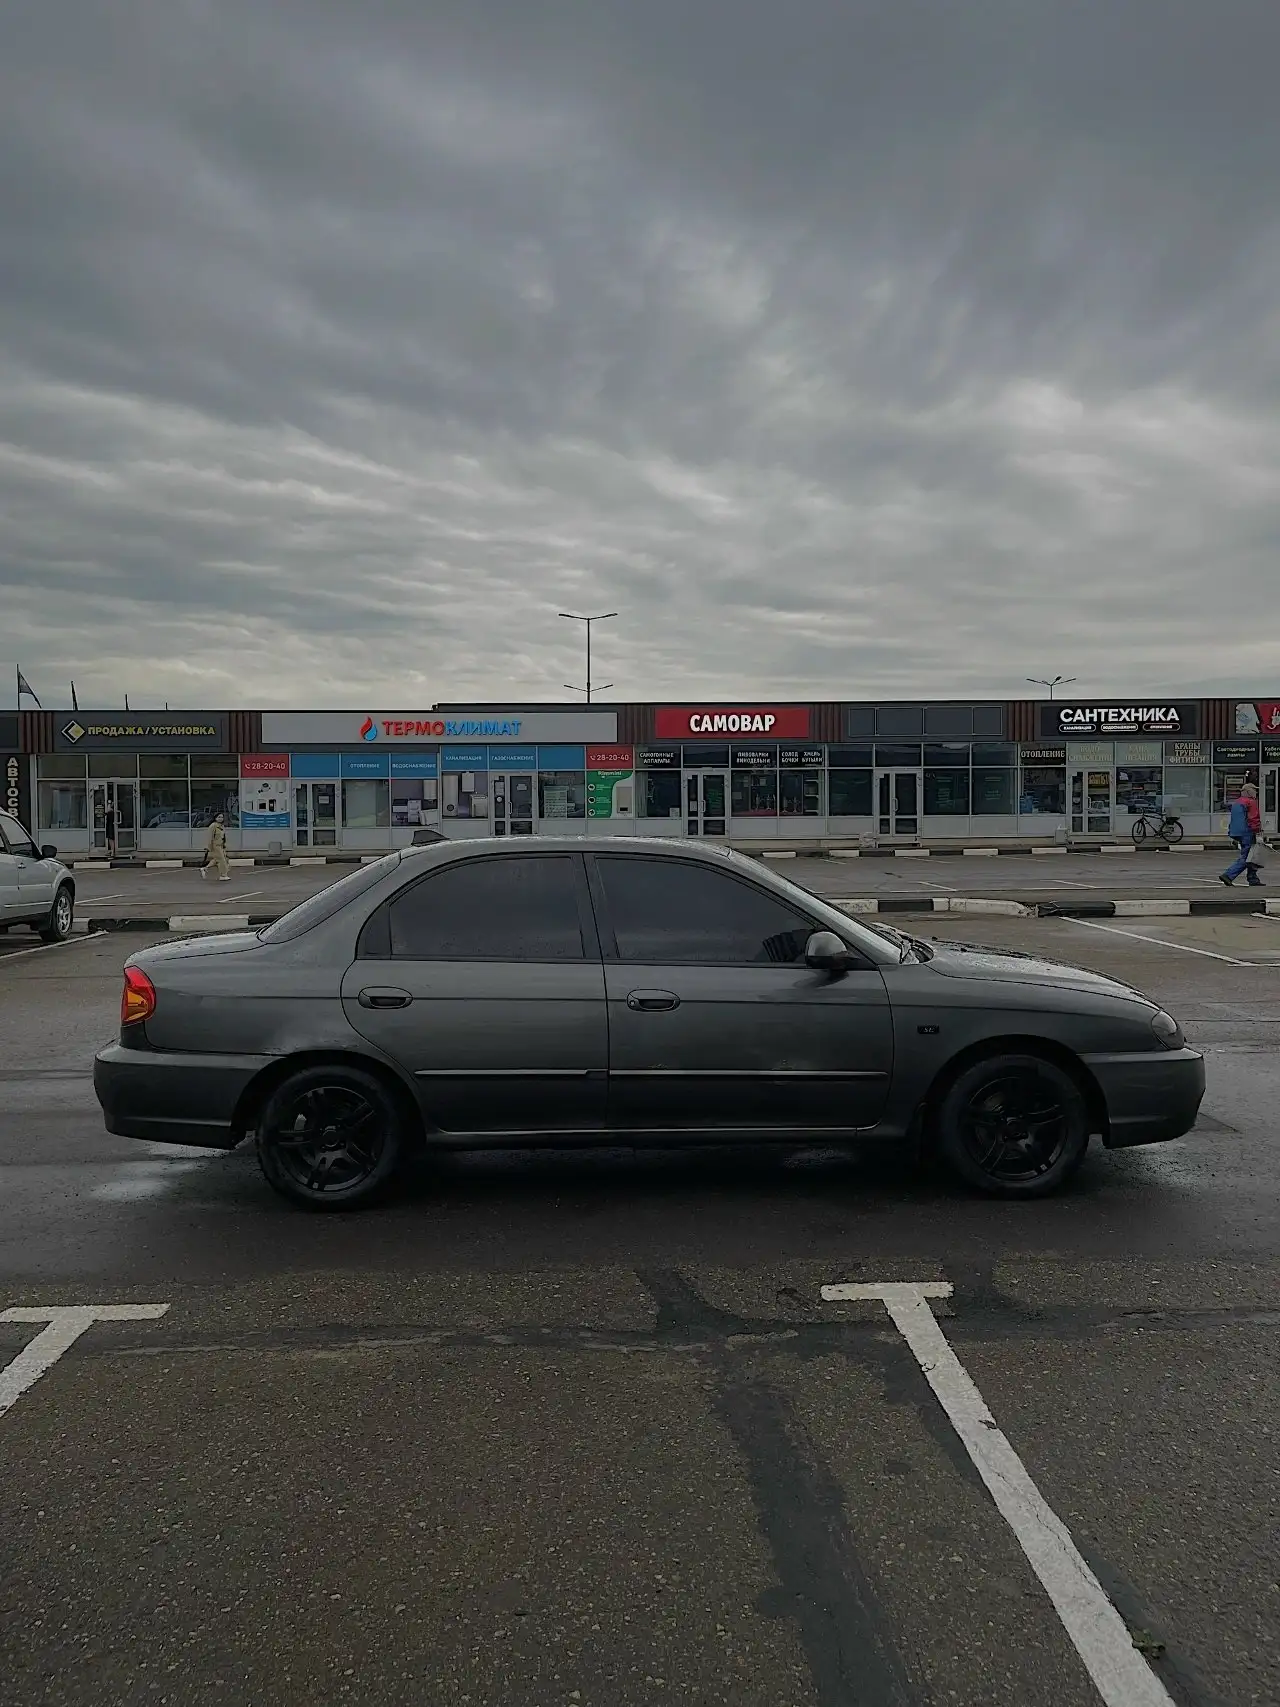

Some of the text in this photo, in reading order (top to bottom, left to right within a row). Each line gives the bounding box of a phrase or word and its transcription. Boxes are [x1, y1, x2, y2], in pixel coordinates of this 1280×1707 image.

[1059, 708, 1180, 722] САНТЕХНИКА
[382, 719, 522, 736] ТЕРМОКЛИМАТ
[689, 714, 776, 732] САМОВАР
[88, 726, 144, 737] ПРОДАЖА
[152, 726, 216, 736] УСТАНОВКА
[1020, 750, 1065, 758] ОТОПЛЕНИЕ
[1174, 749, 1200, 757] ТРУБЫ
[1169, 756, 1206, 764] ФИТИНГИ
[251, 762, 286, 770] 28-20-40
